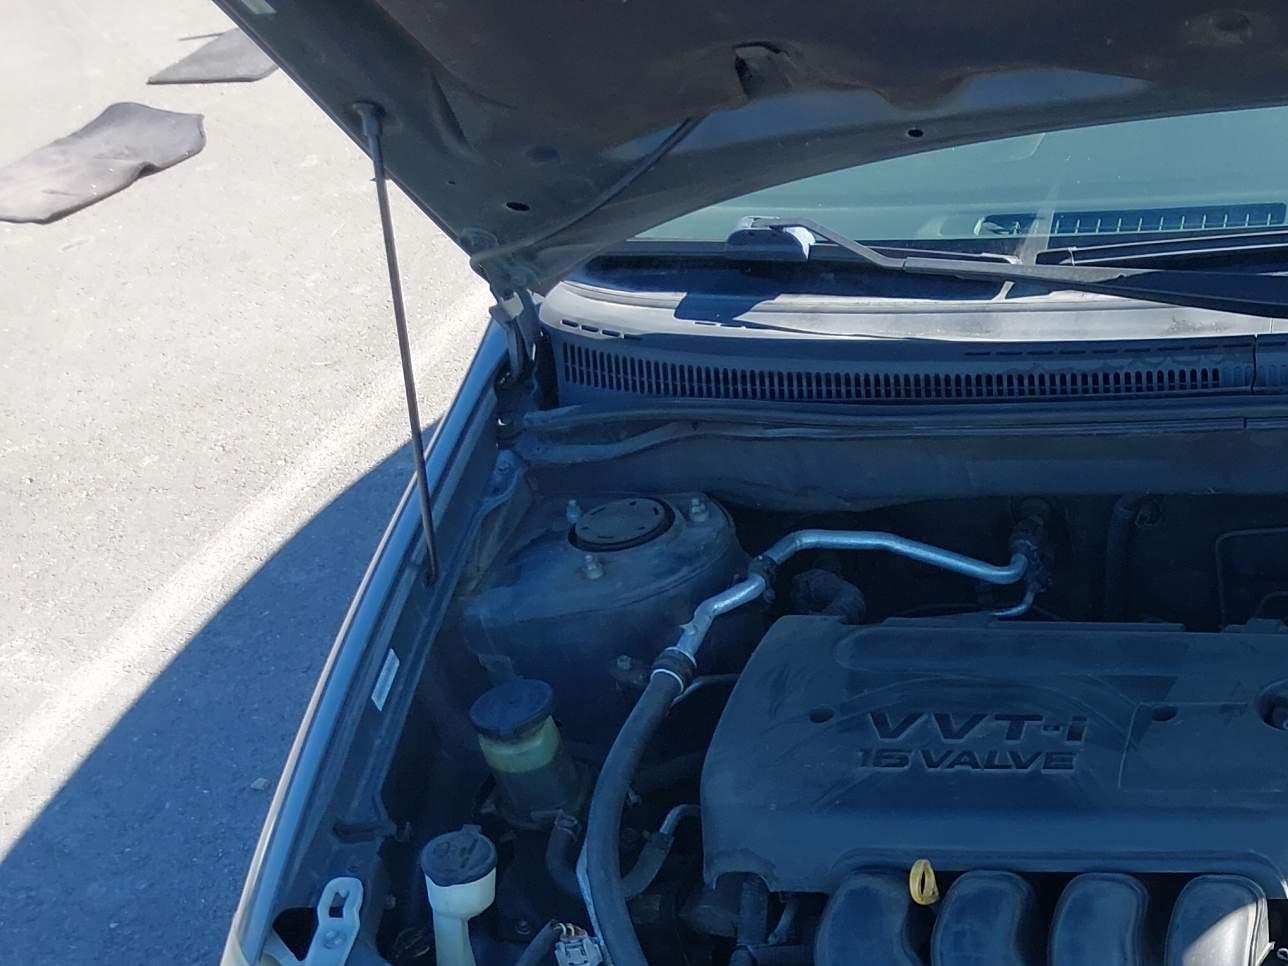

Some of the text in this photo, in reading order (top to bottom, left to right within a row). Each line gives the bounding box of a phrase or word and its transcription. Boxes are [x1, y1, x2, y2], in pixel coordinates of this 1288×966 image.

[867, 712, 1088, 744] VVT-i
[858, 749, 1078, 773] 16 VALVE
